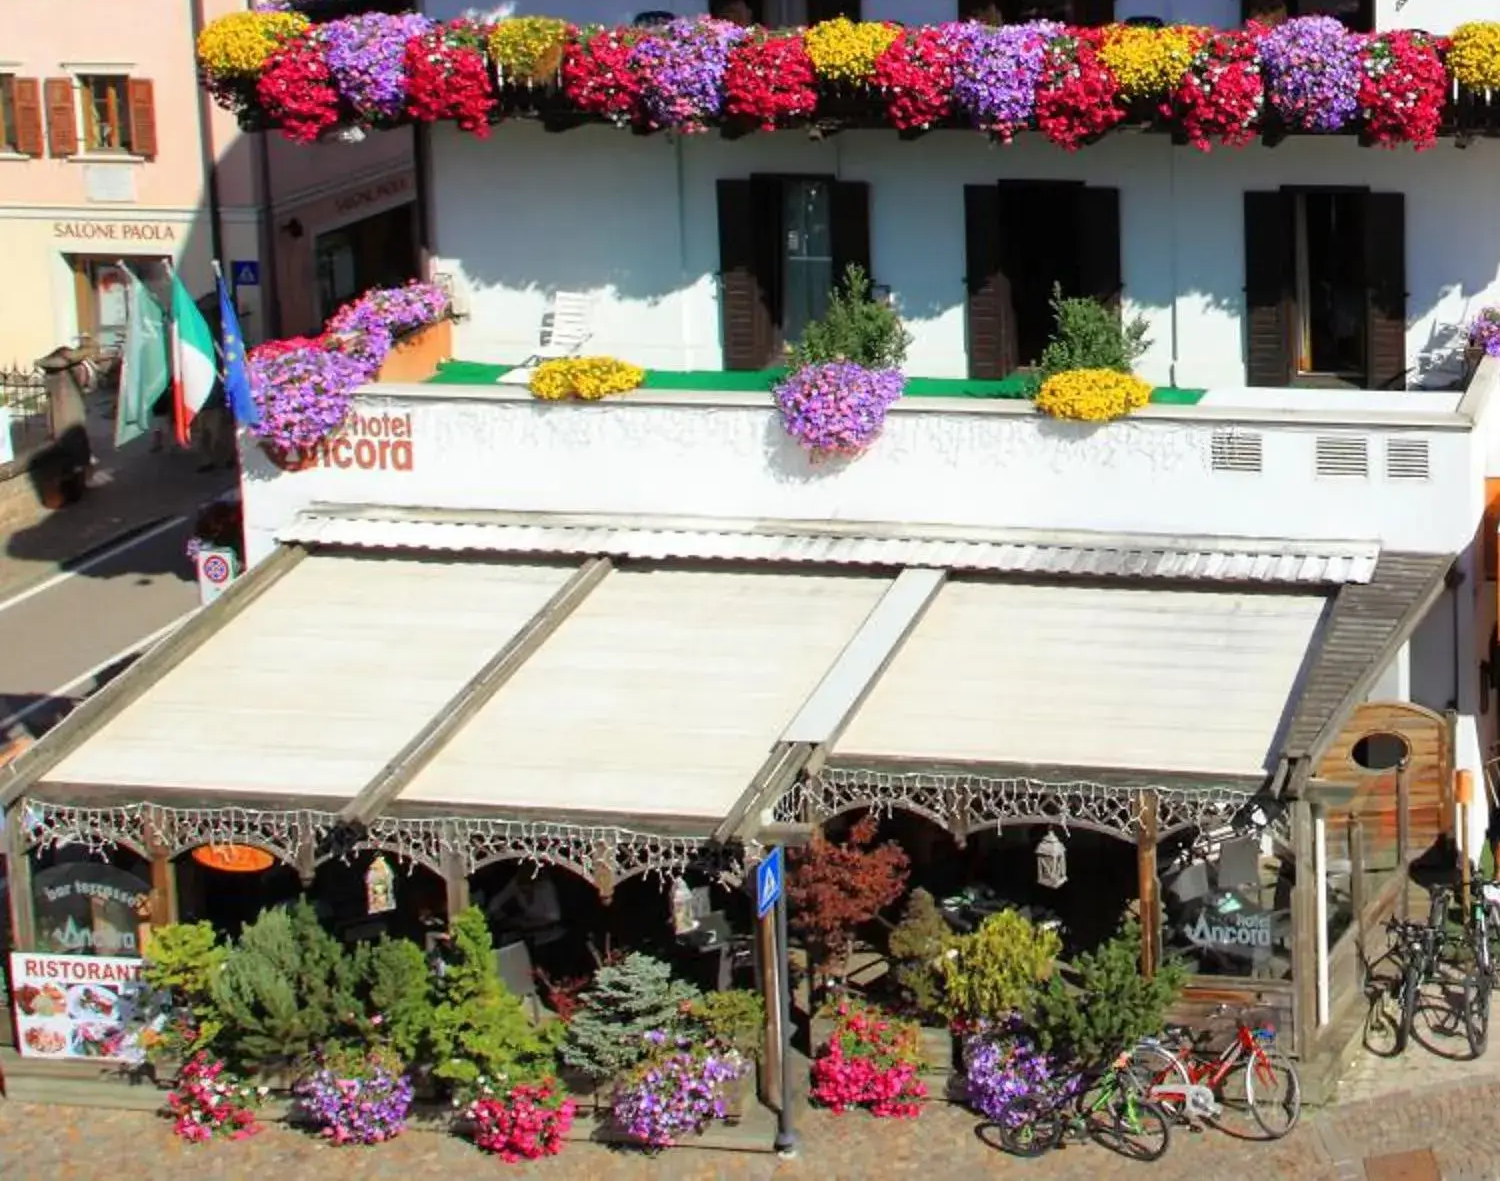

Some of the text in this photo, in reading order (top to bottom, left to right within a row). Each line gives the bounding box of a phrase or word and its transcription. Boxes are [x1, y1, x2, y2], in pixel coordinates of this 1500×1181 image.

[53, 221, 175, 240] SALONE PAOLA
[350, 412, 412, 437] hotel
